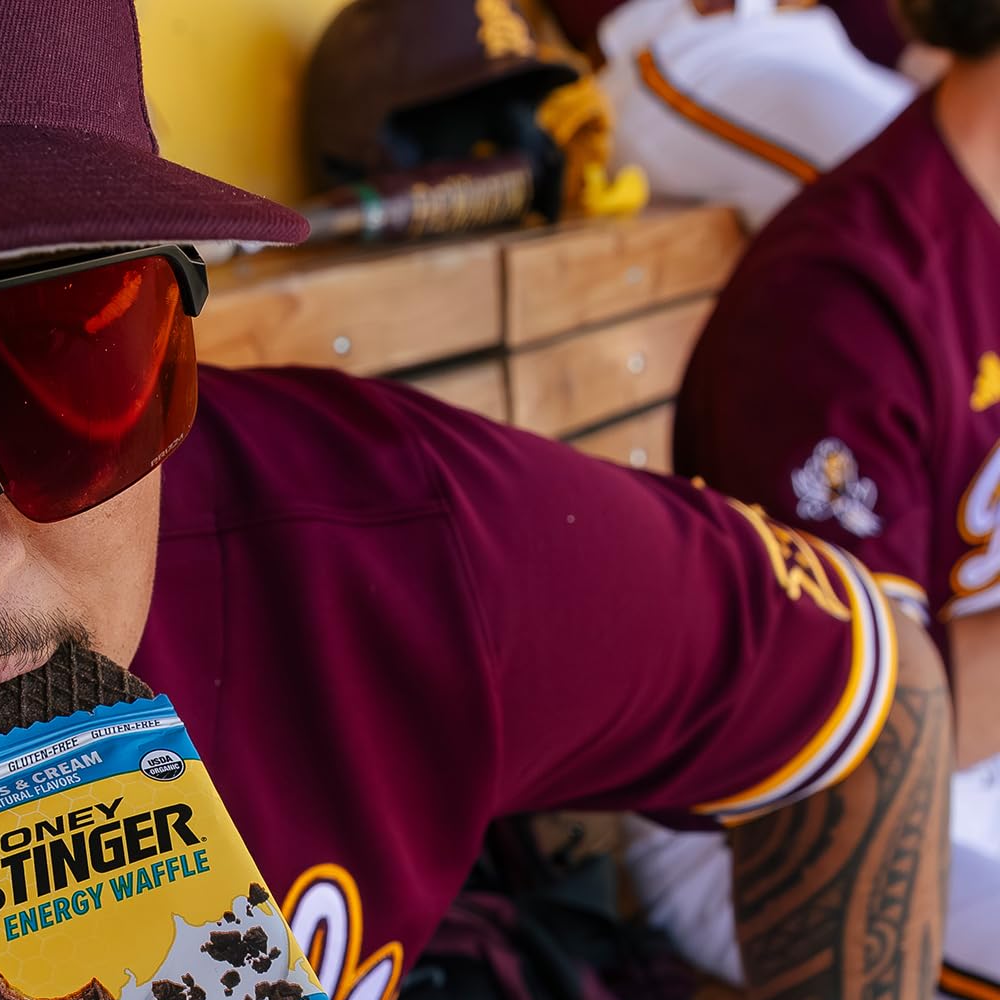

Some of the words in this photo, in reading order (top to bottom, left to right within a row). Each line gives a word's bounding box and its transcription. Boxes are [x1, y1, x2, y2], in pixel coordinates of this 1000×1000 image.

[8, 737, 79, 772] GLUTEN-FREE
[91, 719, 161, 739] GLUTEN-FREE
[147, 754, 174, 767] USDA
[15, 778, 30, 790] &
[32, 750, 103, 784] CREAM
[34, 773, 82, 797] FLAVORS
[149, 763, 181, 776] ORGANIC
[3, 882, 104, 942] ENERGY
[109, 849, 210, 902] WAFFLE
